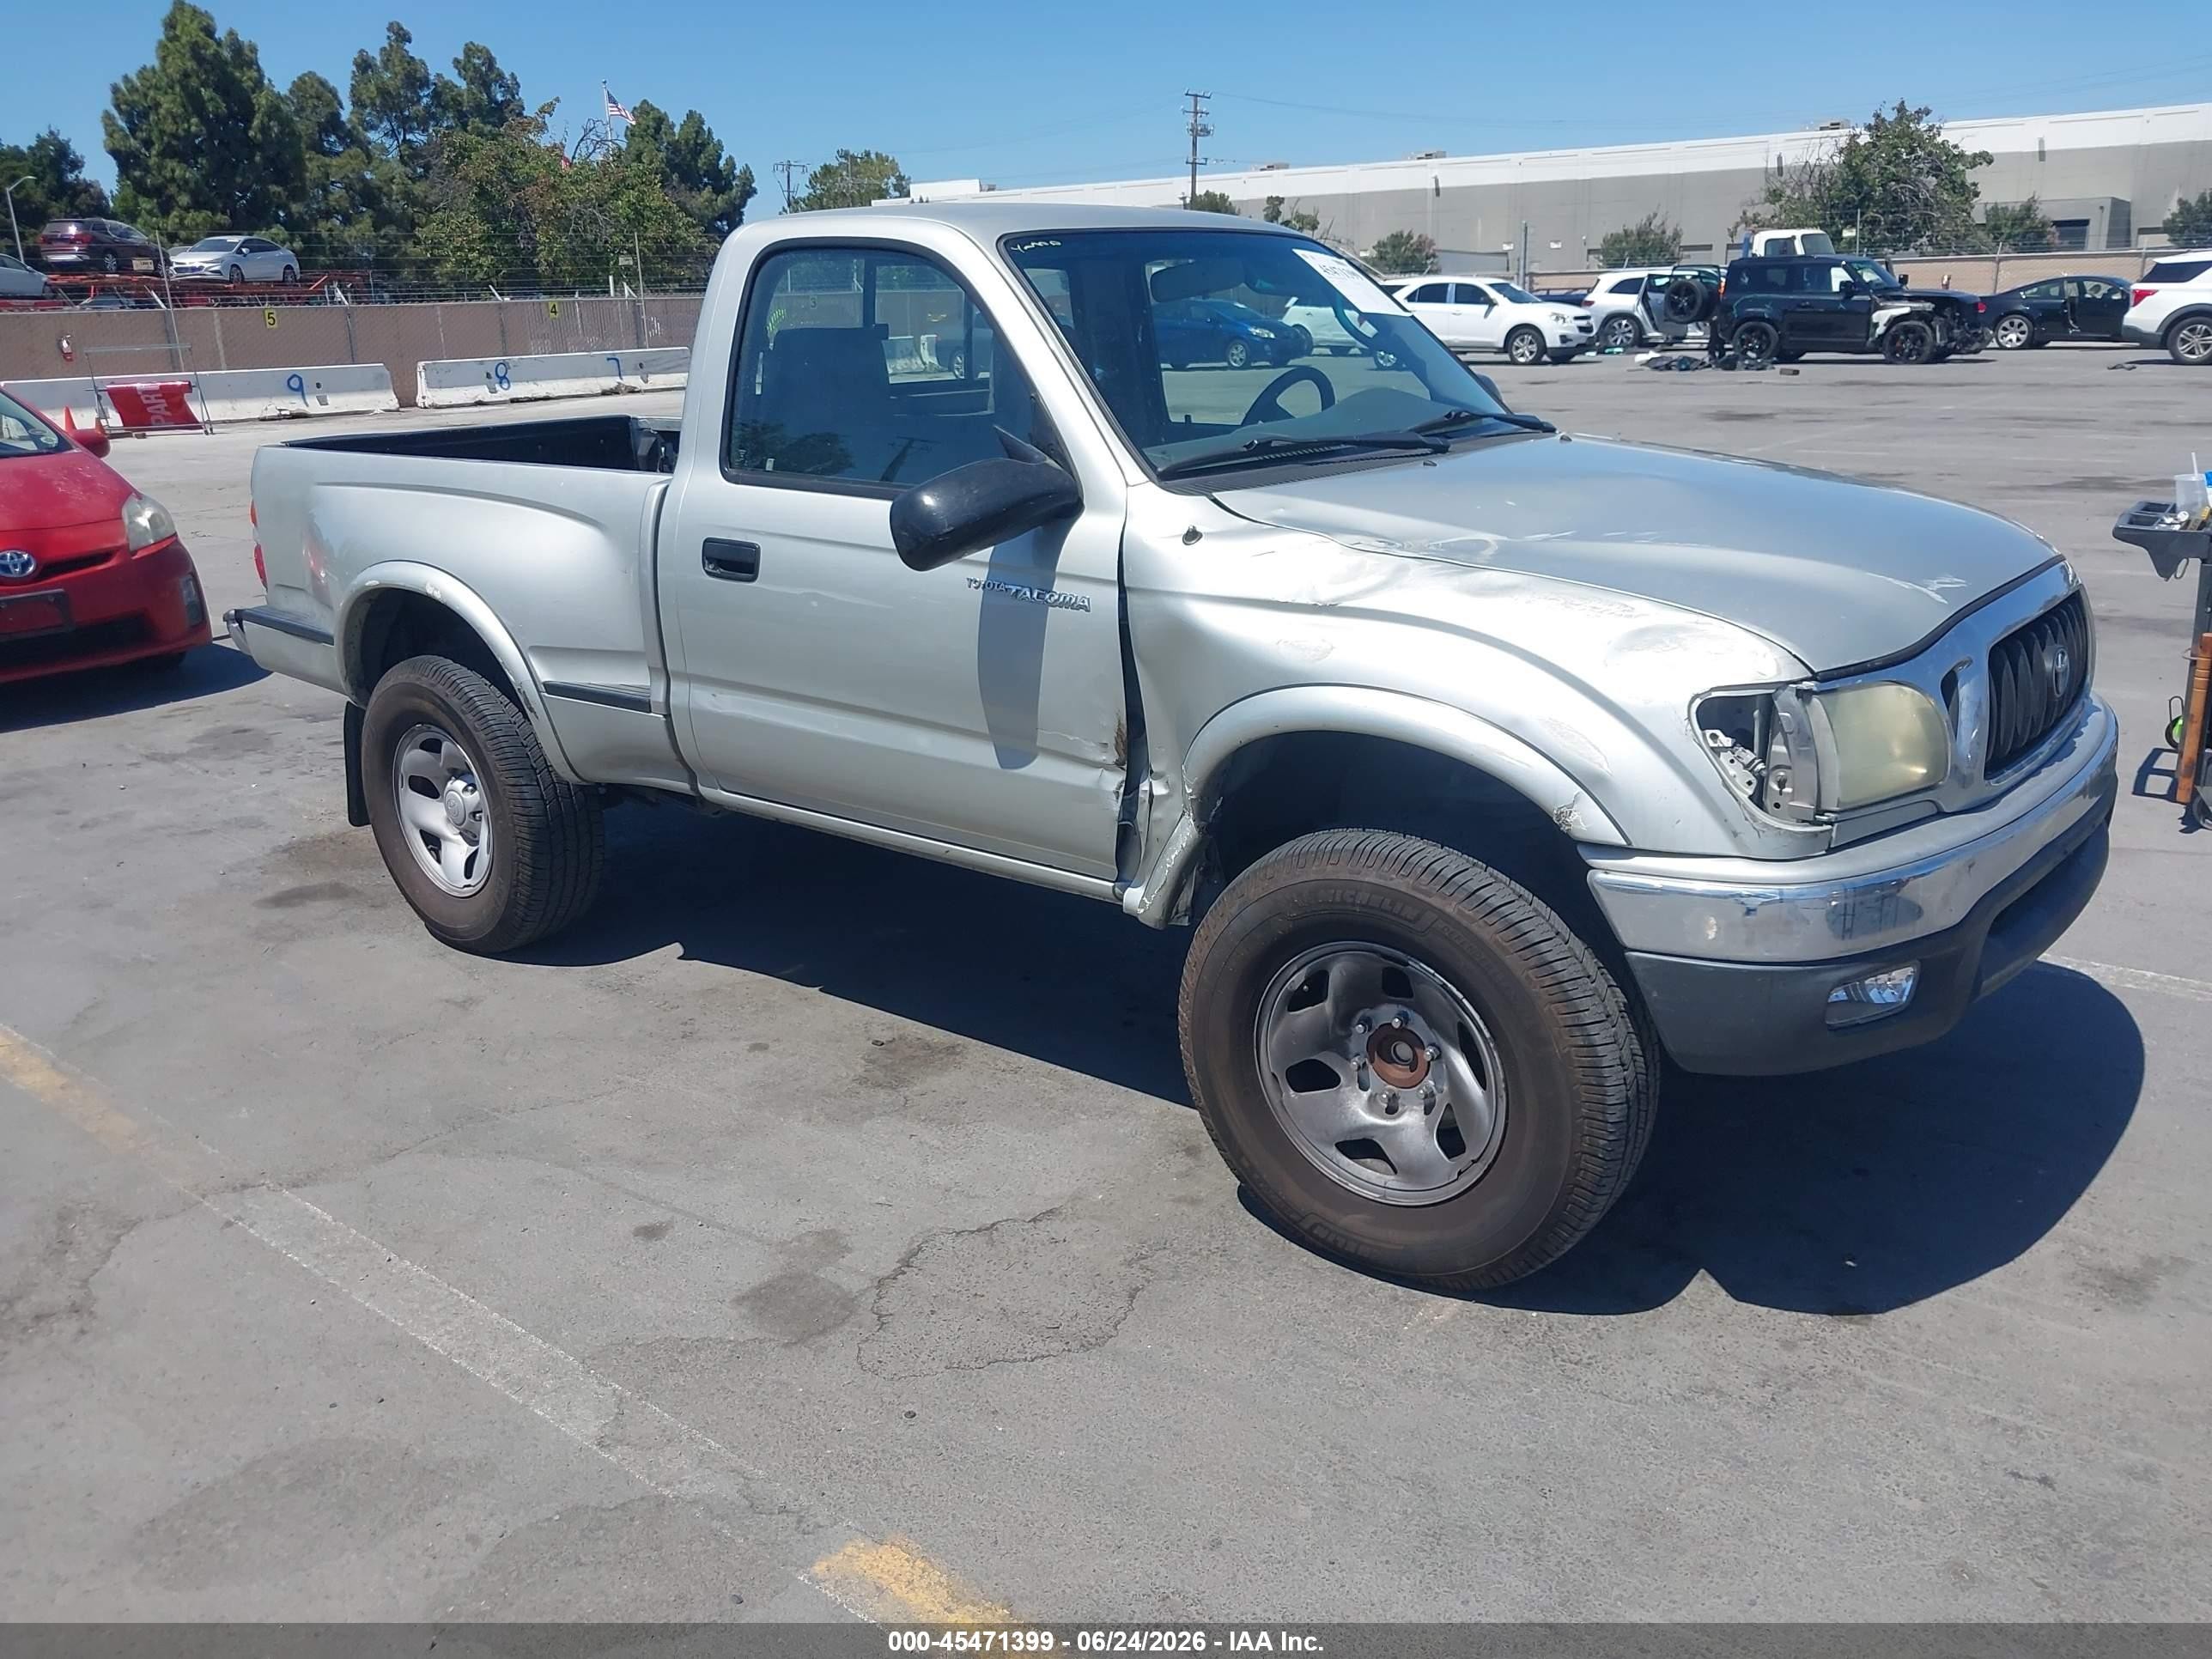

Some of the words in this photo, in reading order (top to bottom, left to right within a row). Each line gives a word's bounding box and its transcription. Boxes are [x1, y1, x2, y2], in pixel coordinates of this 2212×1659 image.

[267, 312, 276, 325] 5
[550, 303, 558, 315] 4
[495, 362, 511, 391] 8
[606, 356, 623, 380] 7
[287, 374, 309, 407] 9
[1006, 584, 1091, 612] TACOMA
